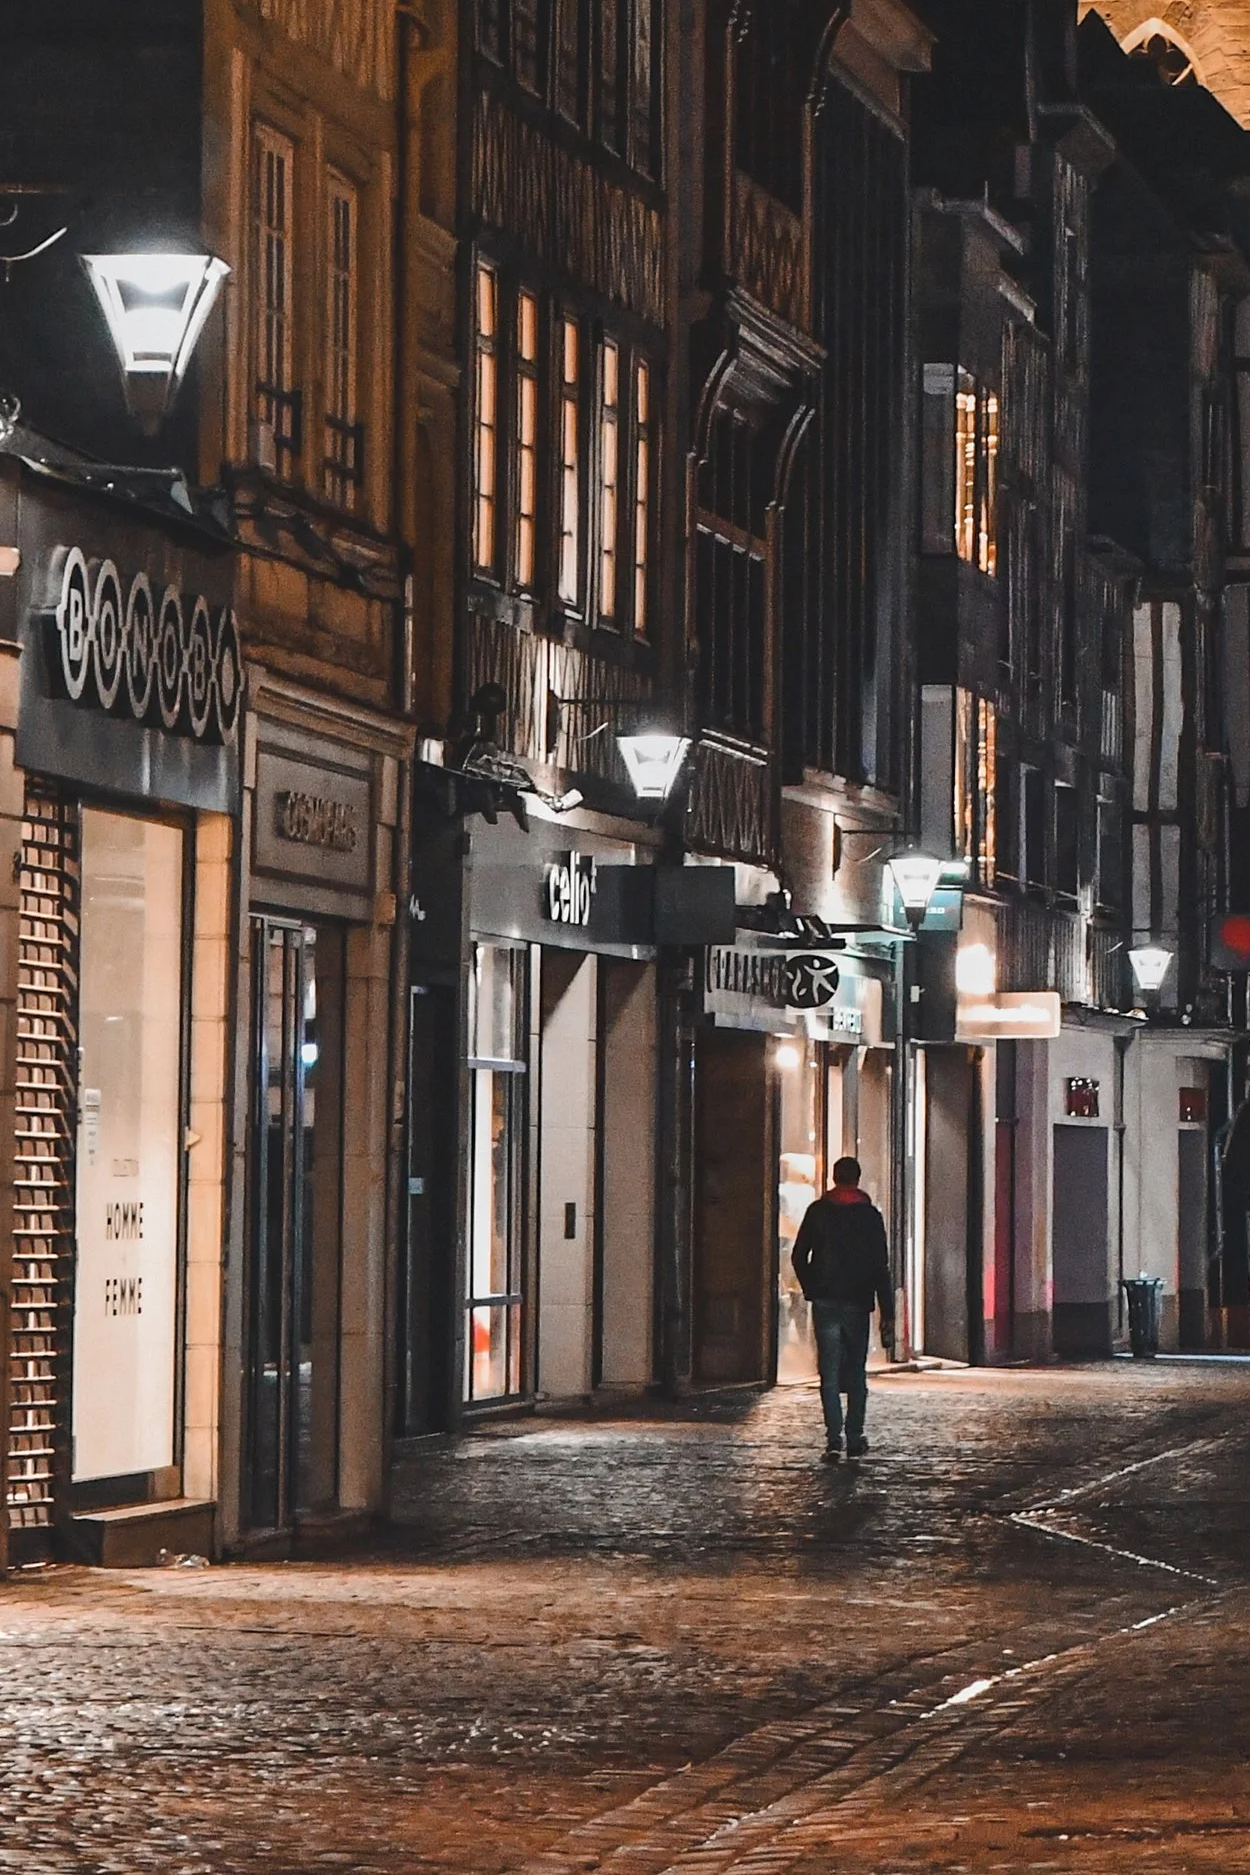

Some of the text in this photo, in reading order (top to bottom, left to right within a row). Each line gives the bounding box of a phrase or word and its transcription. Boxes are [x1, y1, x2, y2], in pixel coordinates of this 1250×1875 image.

[64, 573, 238, 719] BONOBO
[106, 1202, 144, 1240] HOMME
[105, 1277, 143, 1317] FEMME
